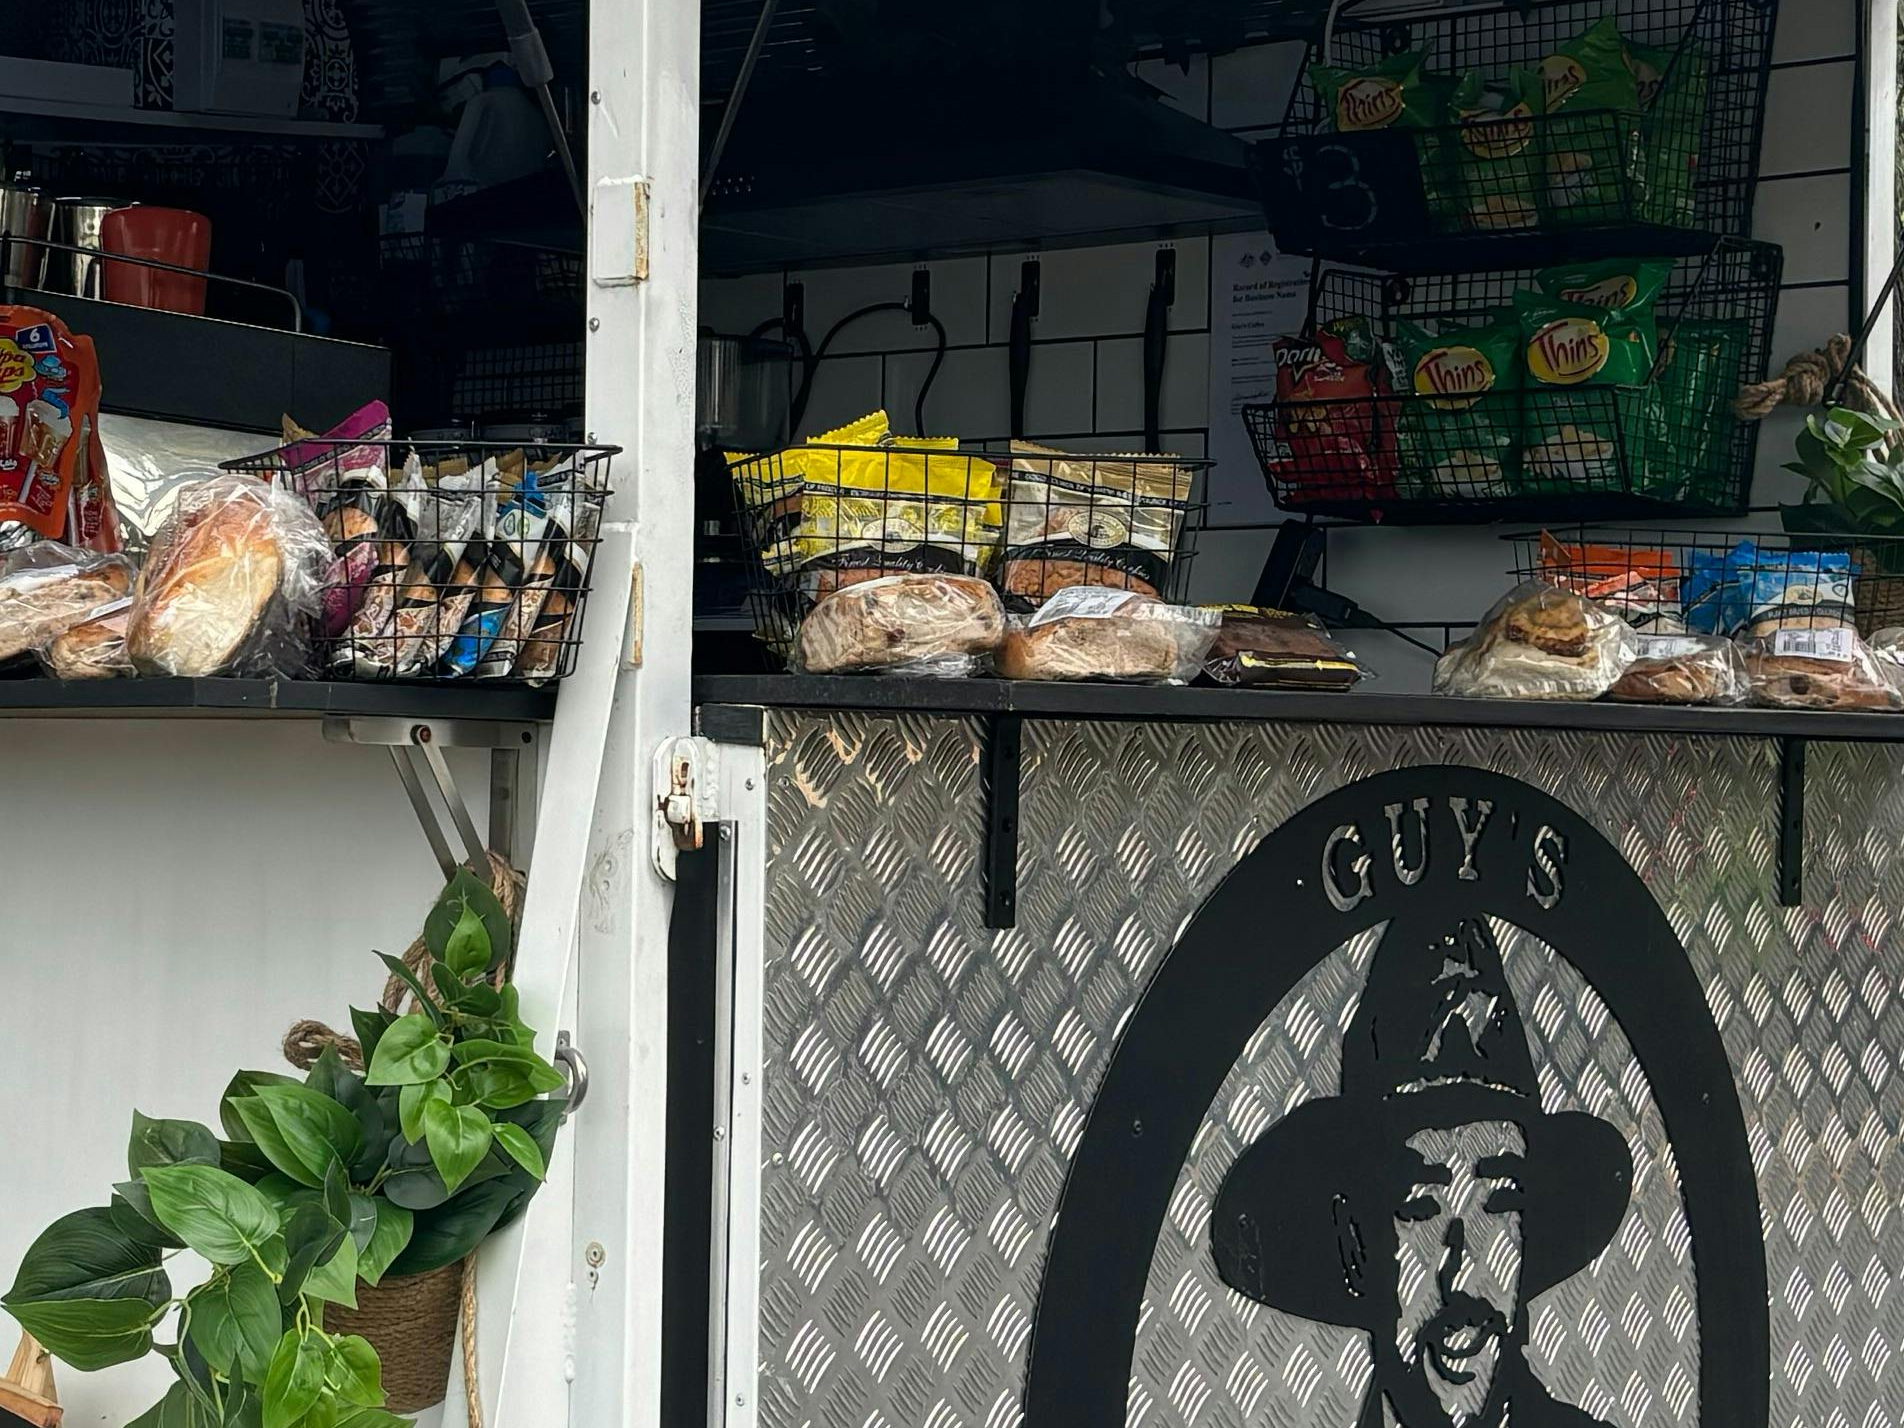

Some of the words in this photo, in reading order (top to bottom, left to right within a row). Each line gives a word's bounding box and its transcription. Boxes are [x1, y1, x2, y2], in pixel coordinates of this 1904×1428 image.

[1417, 351, 1486, 394] Thins
[1531, 321, 1601, 375] Thins
[1322, 796, 1570, 913] GUY'S
